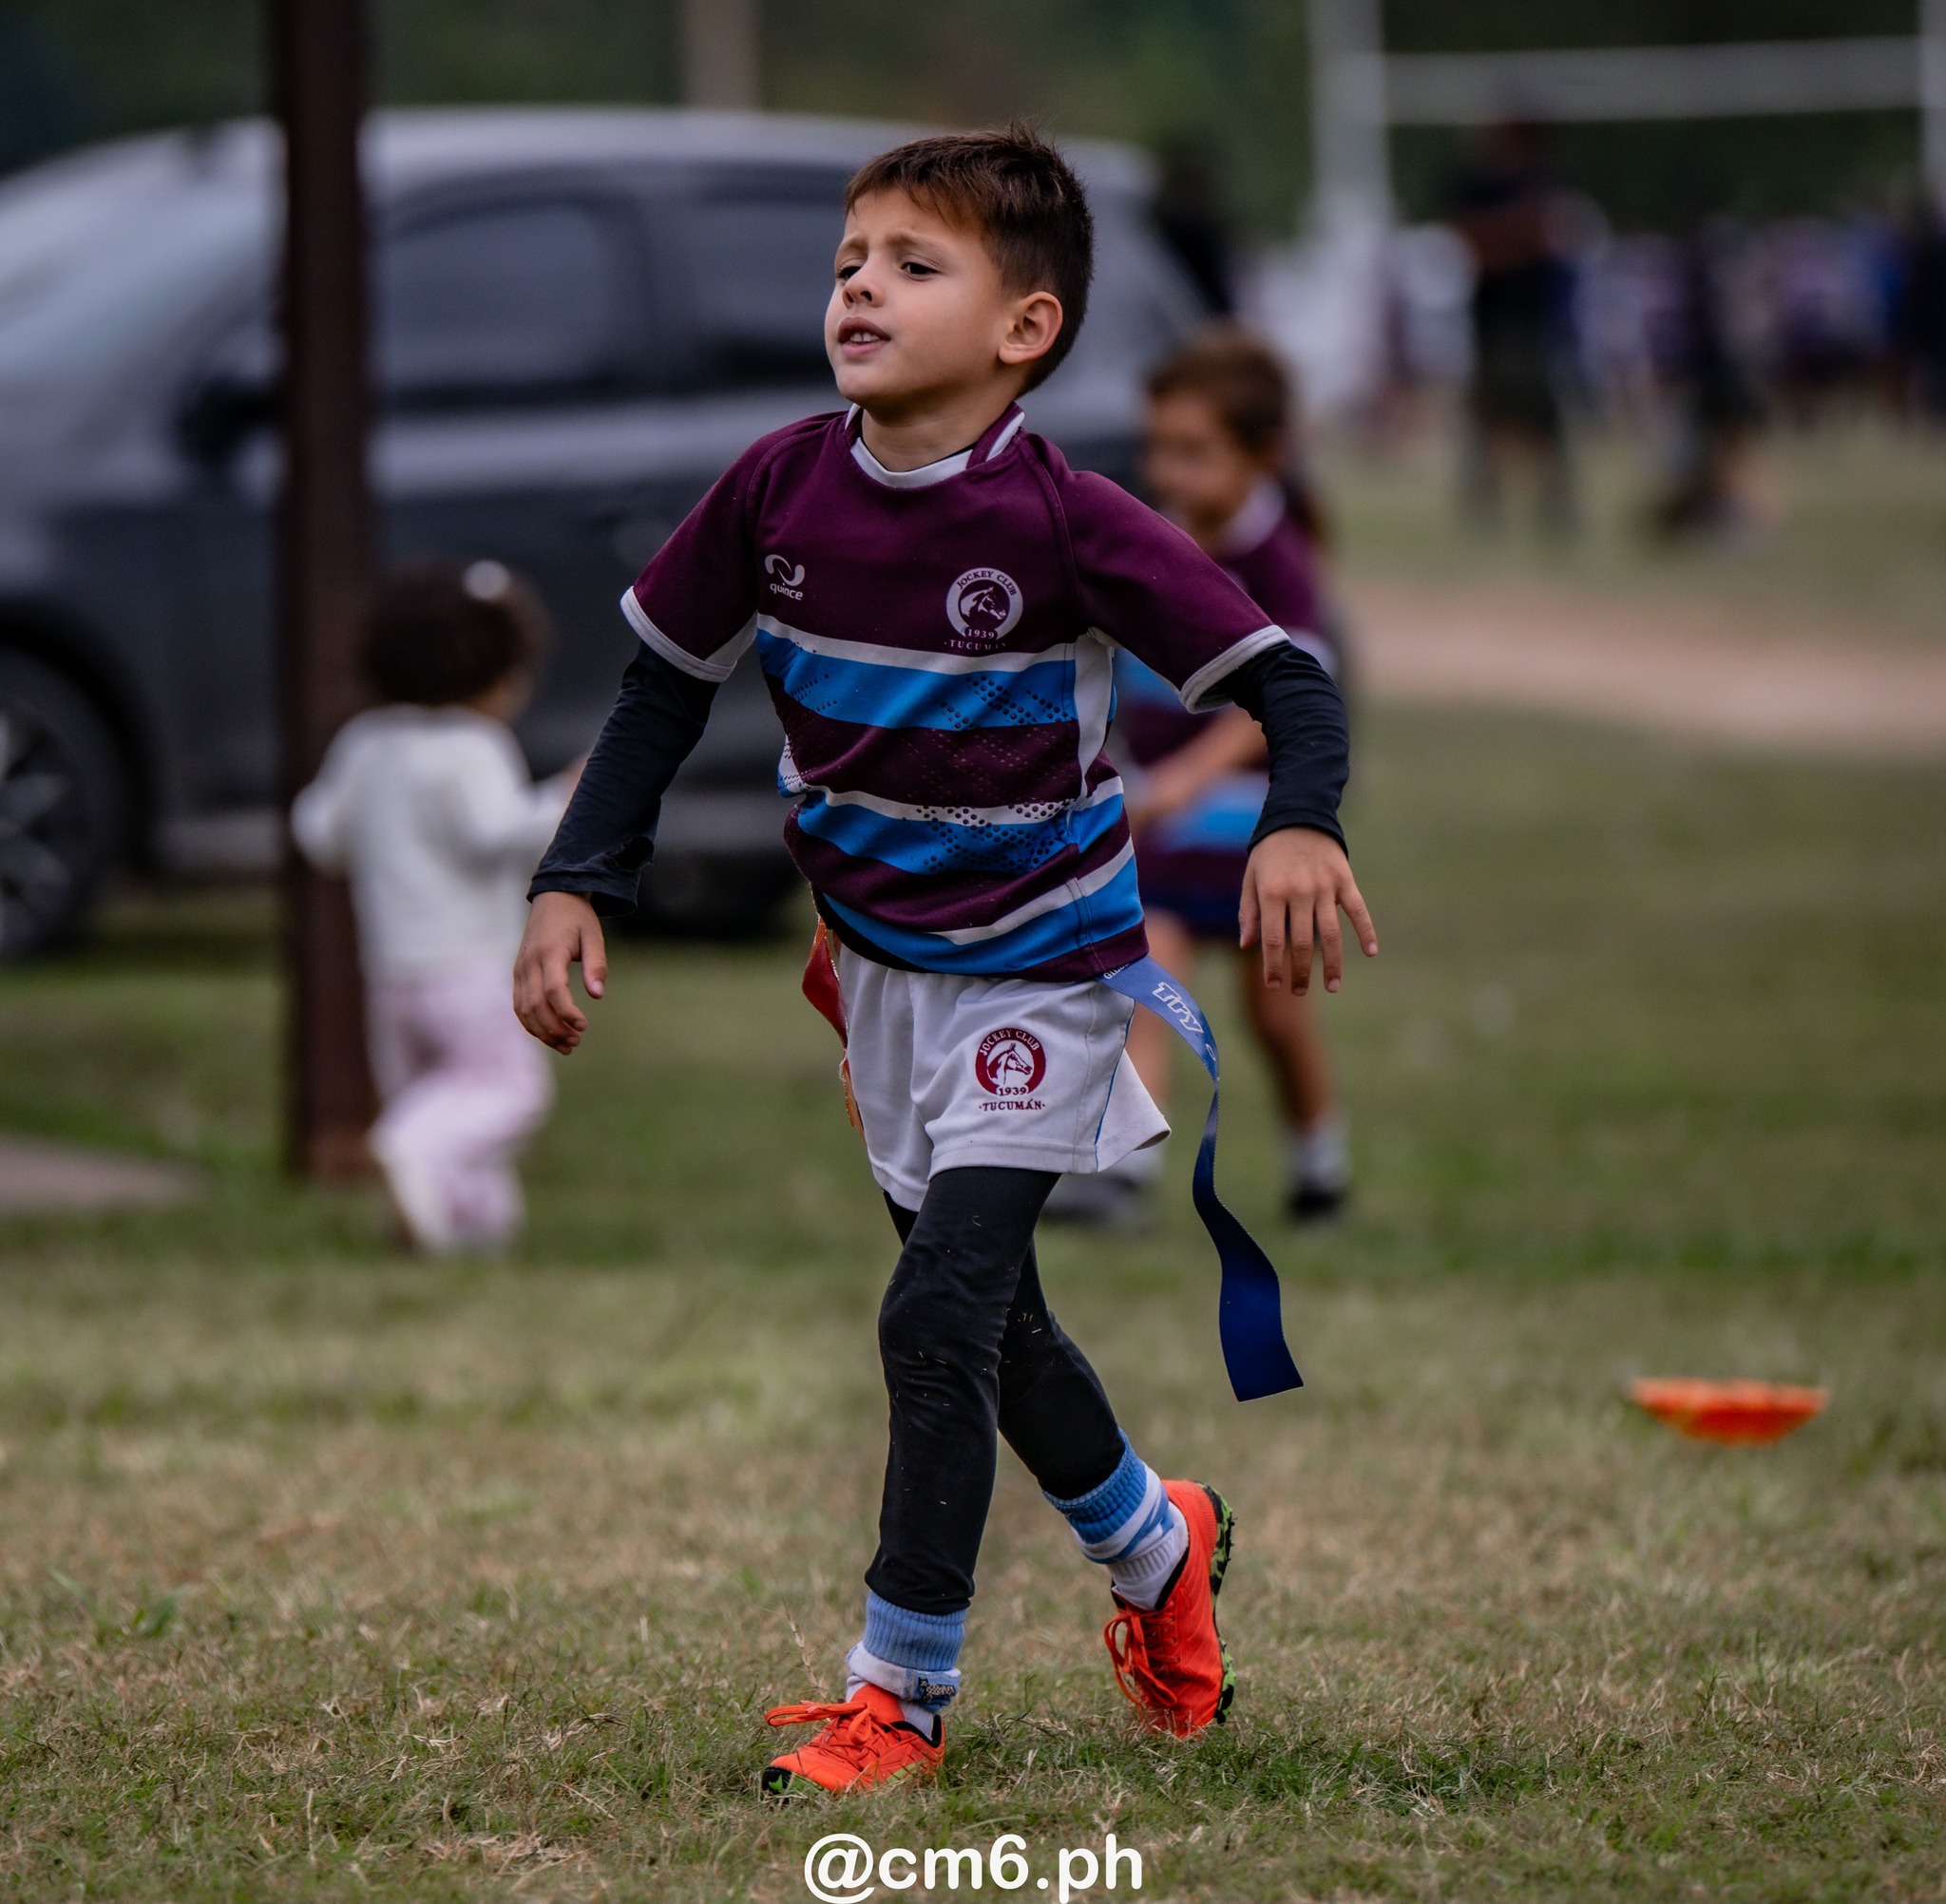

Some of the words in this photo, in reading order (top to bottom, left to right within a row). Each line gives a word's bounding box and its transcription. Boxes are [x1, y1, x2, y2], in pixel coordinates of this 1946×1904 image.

[770, 582, 804, 600] quince
[956, 570, 994, 590] JOCKEY
[996, 574, 1018, 597] CLUB
[967, 629, 995, 639] 1939
[979, 1029, 1012, 1057] JOCKEY
[1015, 1030, 1040, 1051] CLUB
[999, 1087, 1027, 1096] 1939
